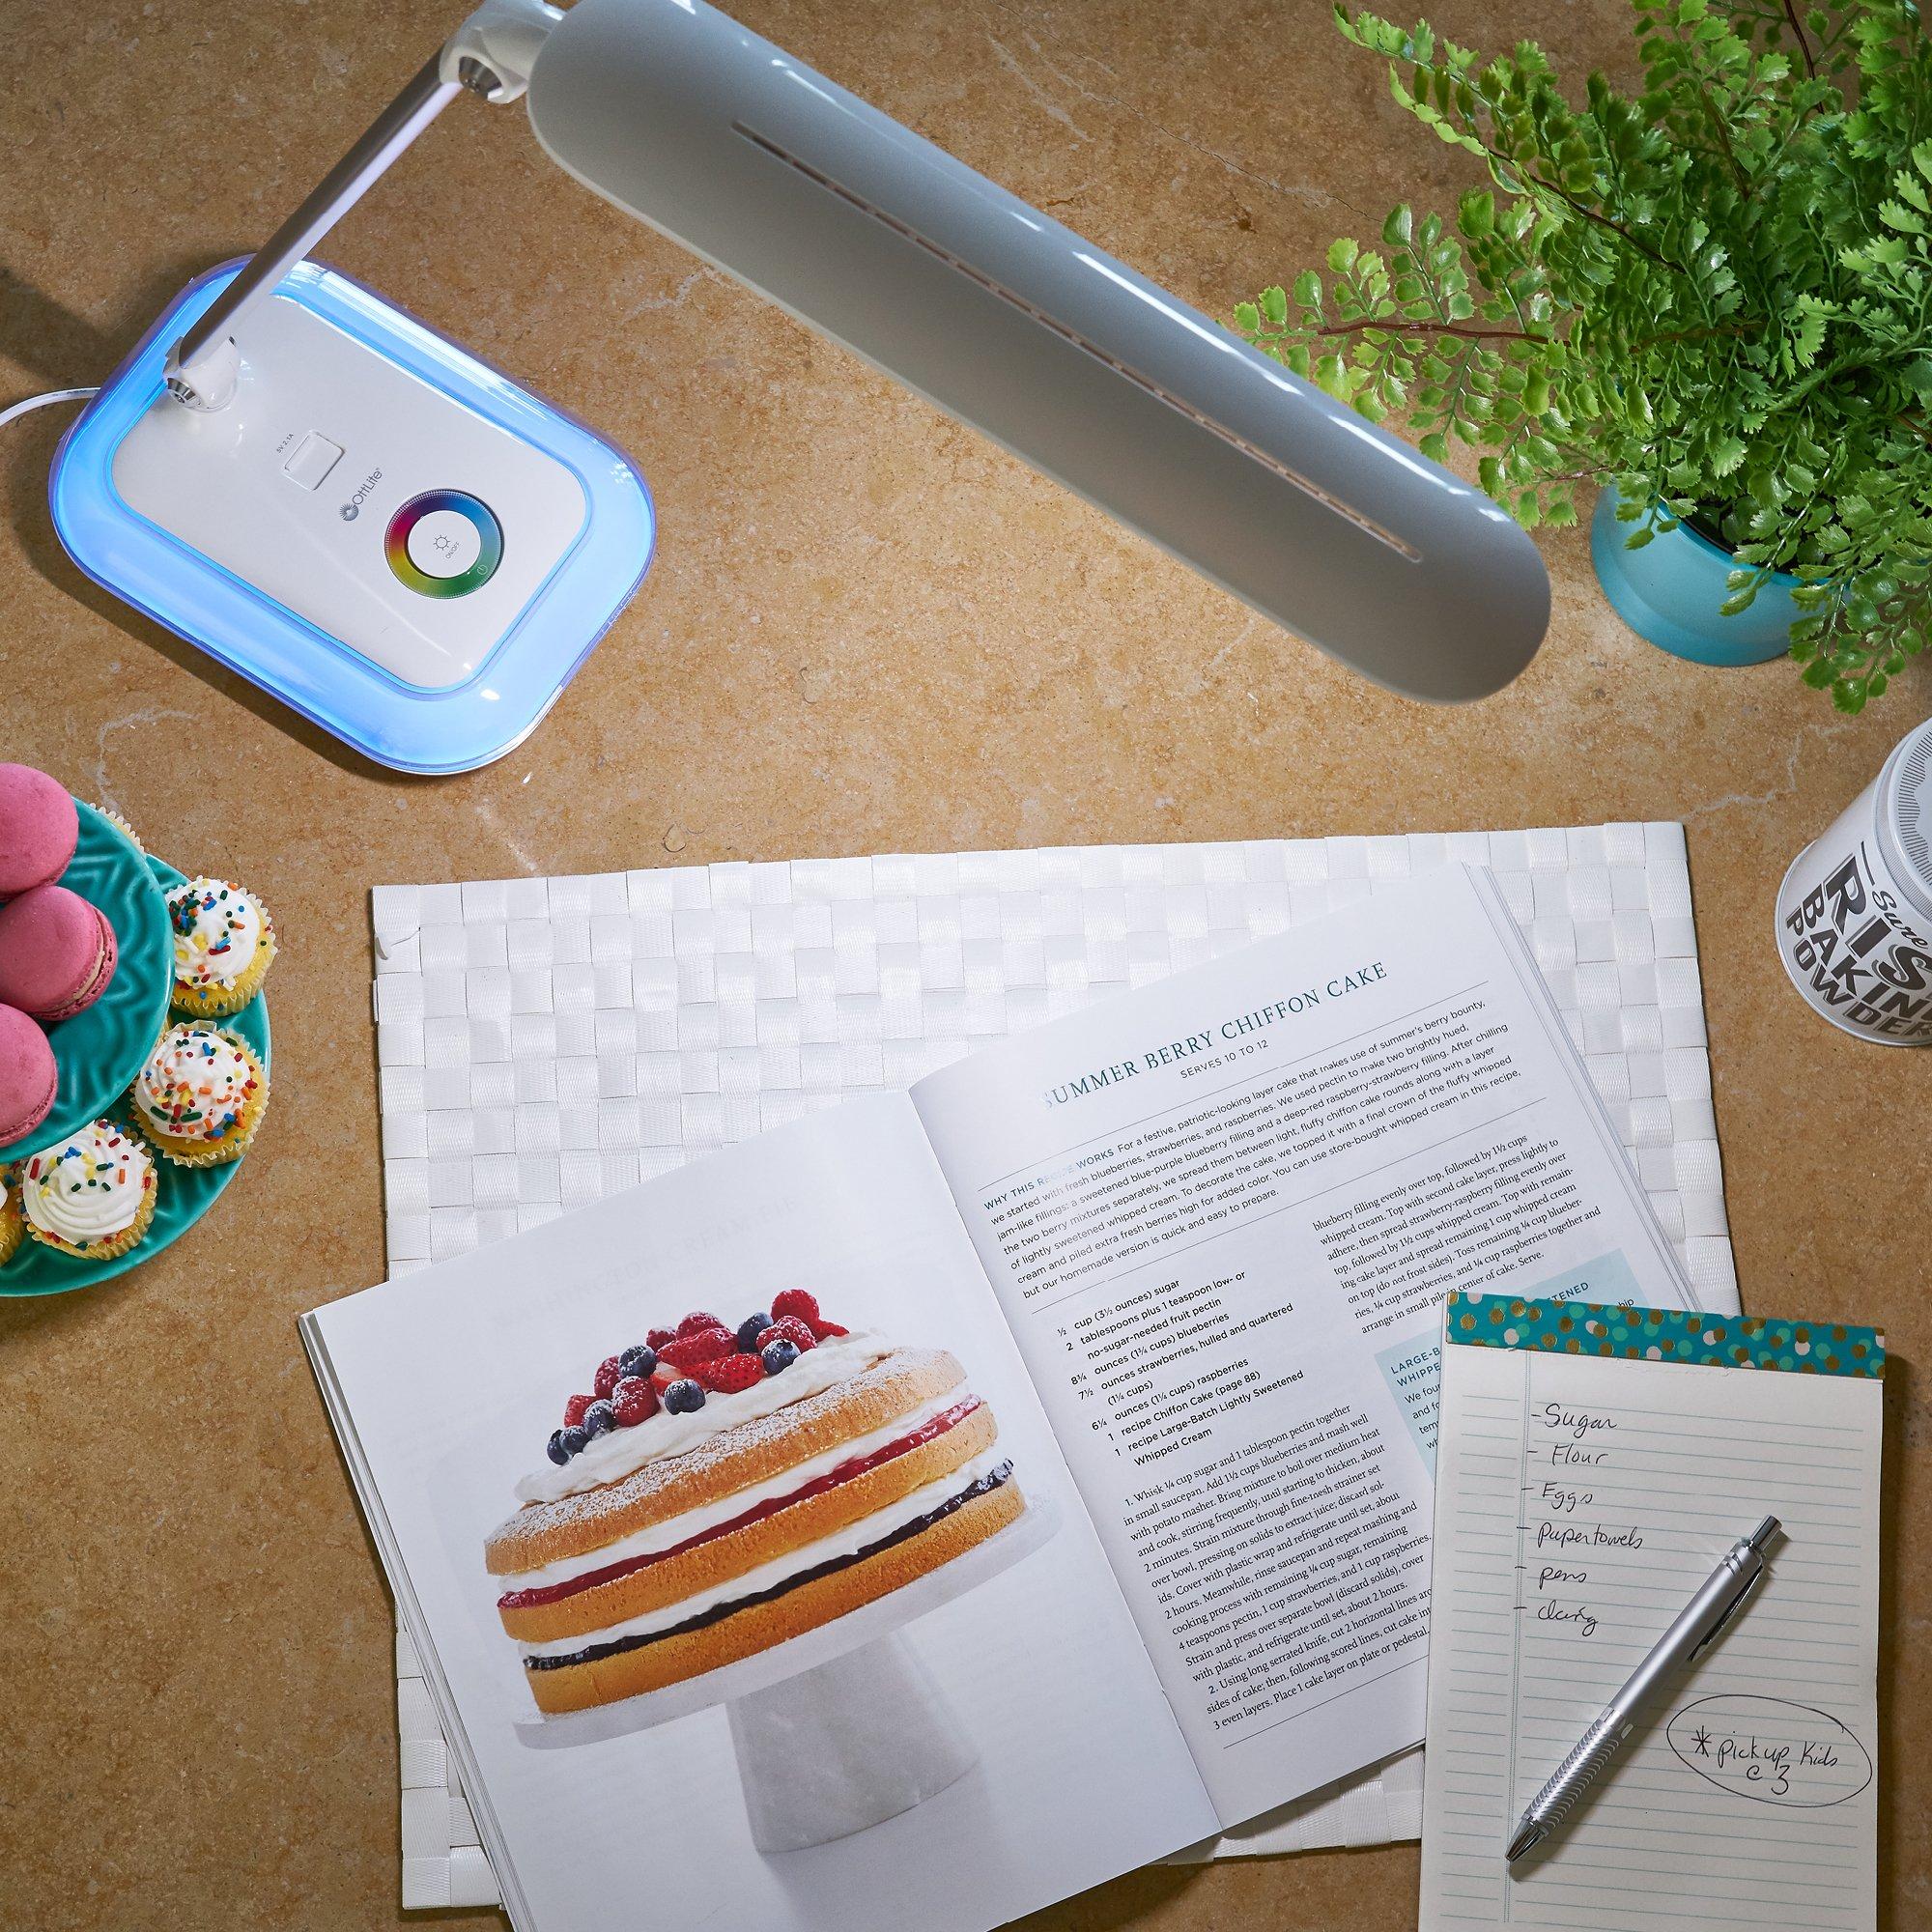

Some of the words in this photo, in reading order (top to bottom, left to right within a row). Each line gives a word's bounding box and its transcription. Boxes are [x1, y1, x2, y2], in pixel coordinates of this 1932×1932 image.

[352, 470, 383, 505] OttLite
[1823, 853, 1932, 992] RIS
[1872, 890, 1929, 950] Sure
[1143, 1030, 1213, 1070] BERRY
[1221, 988, 1321, 1039] CHIFFON
[1326, 961, 1387, 998] CAKE
[1179, 1057, 1223, 1079] SERVES
[1224, 1052, 1236, 1063] 10
[1237, 1044, 1255, 1057] TO
[1256, 1038, 1269, 1050] 12
[983, 1192, 1009, 1210] WHY
[1009, 1181, 1036, 1198] THIS
[1075, 1148, 1115, 1170] WORKS
[1117, 1141, 1134, 1153] For
[1135, 1138, 1143, 1147] a
[1143, 1125, 1177, 1143] festive,
[1177, 1095, 1252, 1131] patriotic-looking
[1251, 1086, 1274, 1100] layer
[1276, 1077, 1298, 1091] cake
[1298, 1067, 1320, 1082] that
[1319, 1057, 1350, 1073] makes
[1350, 1050, 1367, 1062] use
[1368, 1042, 1378, 1054] of
[1423, 1015, 1449, 1031] berry
[1449, 1000, 1486, 1019] bounty,
[996, 1218, 1035, 1243] jam-like
[1035, 1203, 1070, 1223] fillings:
[1079, 1176, 1130, 1204] sweetened
[1129, 1156, 1184, 1182] blue-purple
[1183, 1139, 1228, 1161] blueberry
[1229, 1128, 1256, 1144] filling
[1256, 1119, 1274, 1133] and
[1283, 1098, 1325, 1122] deep-red
[1325, 1061, 1419, 1105] raspberry-strawberry
[1420, 1050, 1450, 1066] filling.
[1451, 1037, 1474, 1054] After
[1475, 1024, 1509, 1043] chilling
[1312, 1209, 1353, 1232] blueberry
[1353, 1199, 1381, 1214] filling
[1379, 1186, 1406, 1204] evenly
[1407, 1179, 1426, 1192] over
[1426, 1172, 1445, 1183] top,
[1443, 1152, 1481, 1176] followed
[1479, 1150, 1492, 1161] by
[1507, 1135, 1528, 1149] cups
[1326, 1243, 1359, 1262] adhere,
[1358, 1234, 1380, 1247] then
[1379, 1219, 1409, 1239] spread
[1408, 1184, 1493, 1227] strawberry-raspberry
[1493, 1173, 1521, 1190] filling
[1520, 1160, 1547, 1179] evenly
[1548, 1152, 1567, 1166] over
[1022, 1285, 1041, 1299] but
[1041, 1278, 1058, 1291] our
[1059, 1255, 1115, 1282] homemade
[1115, 1240, 1151, 1259] version
[1150, 1236, 1160, 1245] is
[1160, 1224, 1187, 1241] quick
[1187, 1215, 1207, 1231] and
[1207, 1208, 1228, 1222] easy
[1229, 1204, 1240, 1213] to
[1240, 1189, 1279, 1210] prepare.
[1065, 1342, 1074, 1351] 2
[1080, 1315, 1140, 1345] tablespoons
[1140, 1305, 1162, 1321] plus
[1161, 1301, 1168, 1310] 1
[1168, 1285, 1212, 1308] teaspoon
[1211, 1278, 1234, 1290] low-
[1235, 1271, 1245, 1281] or
[1073, 1317, 1093, 1330] cup
[1114, 1290, 1152, 1312] ounces)
[1153, 1280, 1179, 1296] sugar
[1087, 1318, 1170, 1360] no-sugar-needed
[1169, 1310, 1192, 1325] fruit
[1191, 1298, 1222, 1318] pectin
[1094, 1354, 1129, 1376] ounces
[1149, 1334, 1177, 1351] cups)
[1176, 1313, 1230, 1340] blueberries
[1100, 1370, 1136, 1390] ounces
[1137, 1345, 1199, 1375] strawberries,
[1197, 1329, 1229, 1349] hulled
[1229, 1321, 1248, 1336] and
[1248, 1302, 1294, 1328] quartered
[1107, 1433, 1115, 1441] 1
[1121, 1417, 1152, 1436] recipe
[1152, 1402, 1189, 1422] Chiffon
[1189, 1391, 1214, 1406] Cake
[1214, 1378, 1243, 1397] (page
[1243, 1370, 1261, 1383] 88)
[1114, 1401, 1150, 1421] ounces
[1168, 1379, 1196, 1398] cups)
[1196, 1358, 1249, 1386] raspberries
[1114, 1448, 1122, 1457] 1
[1127, 1433, 1159, 1452] recipe
[1159, 1406, 1219, 1437] Large-Batch
[1218, 1393, 1252, 1412] Lightly
[1252, 1369, 1304, 1398] Sweetened
[1125, 1379, 1153, 1398] cups)
[1405, 1393, 1422, 1404] We
[1412, 1406, 1431, 1420] and
[1133, 1440, 1180, 1466] Whipped
[1180, 1428, 1213, 1446] Cream
[1545, 1404, 1618, 1438] Sugar
[1124, 1498, 1134, 1507] 1.
[1132, 1484, 1165, 1502] Whisk
[1176, 1473, 1193, 1486] cup
[1193, 1462, 1218, 1479] sugar
[1218, 1452, 1236, 1467] and
[1235, 1450, 1242, 1461] 1
[1241, 1433, 1289, 1457] tablespoon
[1289, 1420, 1316, 1440] pectin
[1315, 1405, 1350, 1426] together
[1552, 1443, 1609, 1465] Flour
[1543, 1482, 1593, 1513] Eggs
[1172, 1614, 1209, 1635] cooking
[1208, 1599, 1243, 1622] process
[1242, 1588, 1264, 1604] with
[1263, 1570, 1310, 1595] remaining
[1319, 1557, 1336, 1570] cup
[1336, 1546, 1363, 1563] sugar,
[1362, 1525, 1408, 1551] remaining
